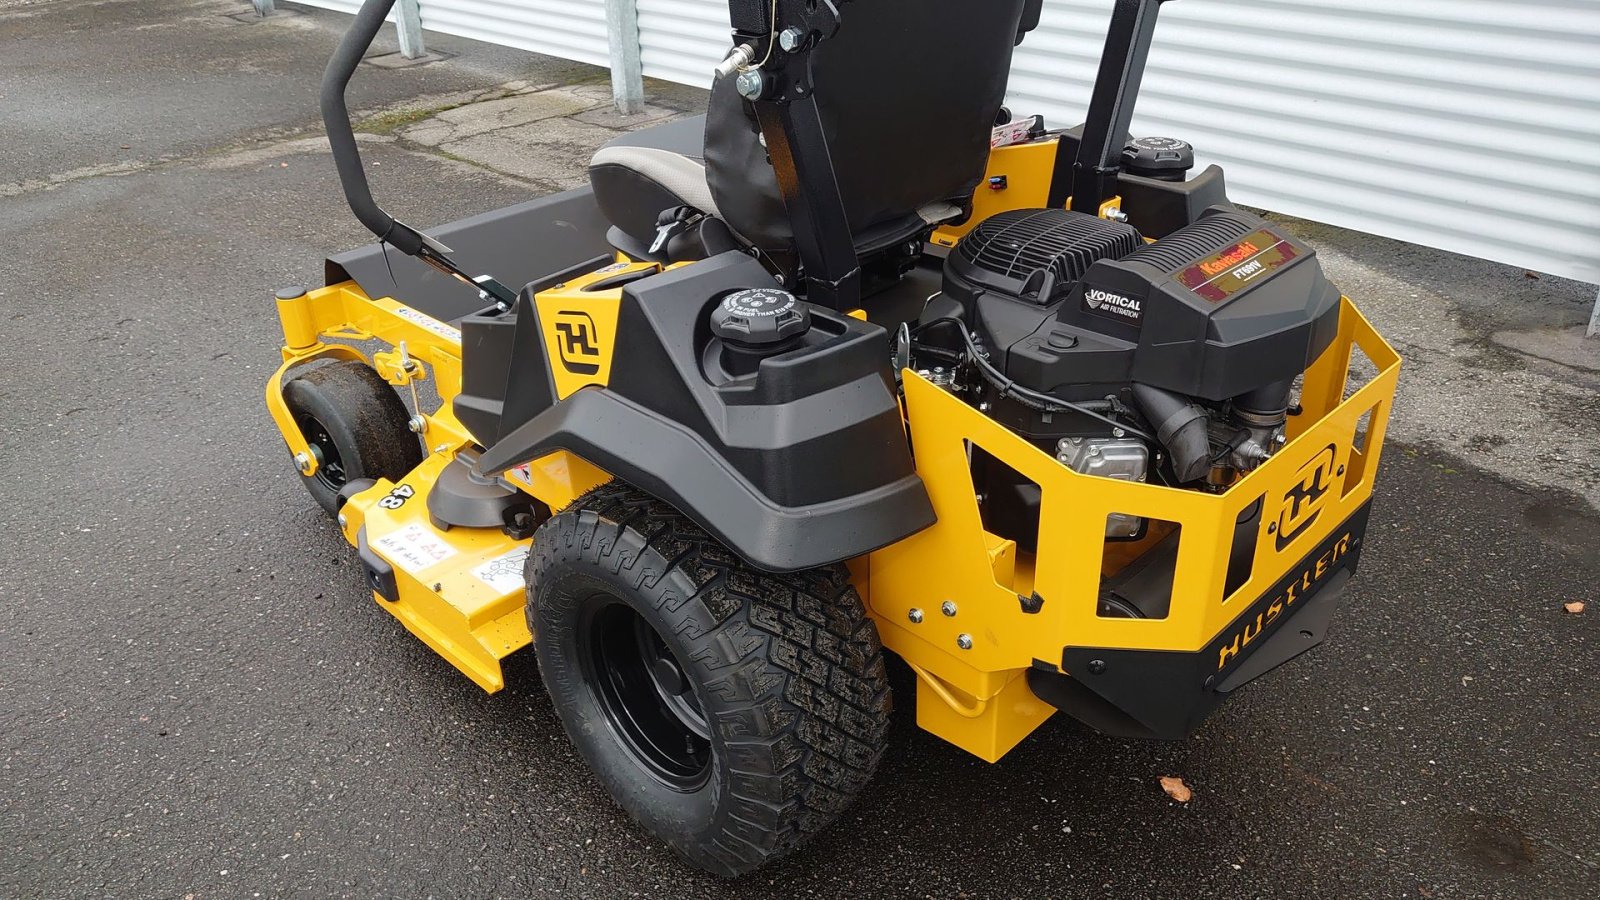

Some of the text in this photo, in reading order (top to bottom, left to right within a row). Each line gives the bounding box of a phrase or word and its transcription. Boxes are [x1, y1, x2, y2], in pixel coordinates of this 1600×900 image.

[1200, 241, 1260, 275] Kawasaki
[1232, 259, 1262, 279] FT691V
[1090, 288, 1141, 311] VORTICAL
[1100, 303, 1139, 319] AIR FILTRATION
[378, 484, 415, 509] 48
[1218, 531, 1352, 671] HUSTLER
